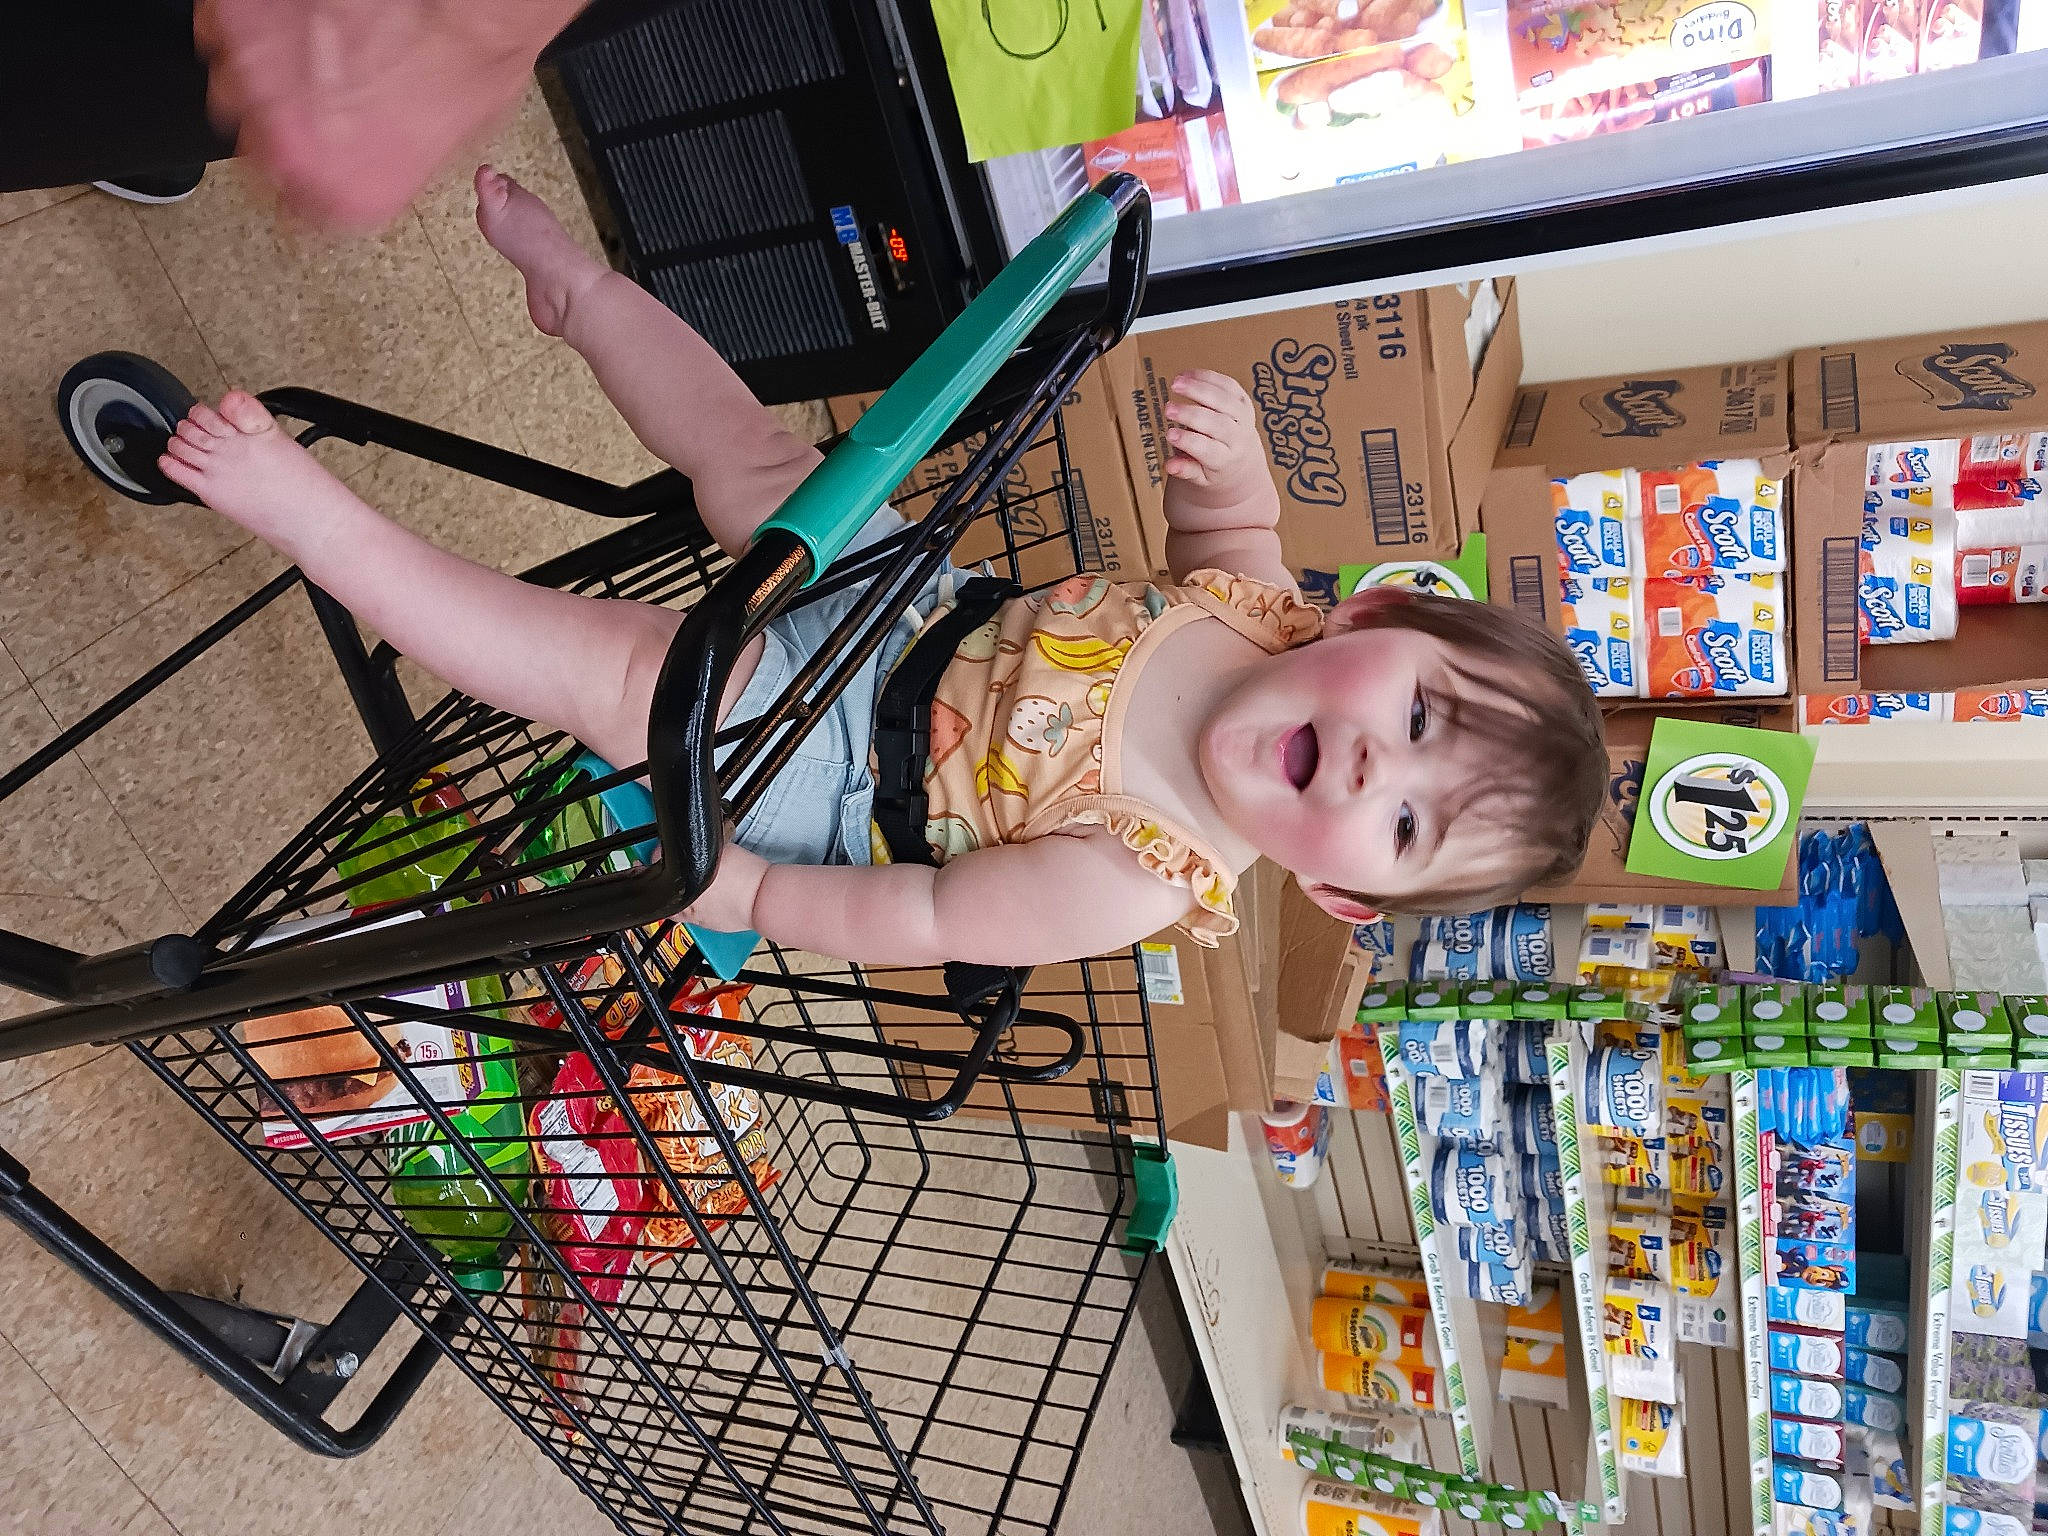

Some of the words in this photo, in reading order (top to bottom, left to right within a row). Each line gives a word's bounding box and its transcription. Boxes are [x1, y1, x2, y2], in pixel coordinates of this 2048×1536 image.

[1682, 18, 1743, 48] Dino
[829, 205, 859, 246] MB
[847, 241, 887, 330] MASTER-BILT
[1352, 315, 1371, 332] pk
[1373, 294, 1407, 361] 3116
[1251, 361, 1289, 412] and
[1934, 354, 2032, 396] Scott
[1131, 389, 1150, 430] MADE
[1270, 338, 1347, 508] Strong
[1140, 431, 1155, 449] IN
[1262, 412, 1300, 471] Soft
[1906, 452, 1931, 480] Scott
[1606, 497, 1623, 508] 4
[1758, 484, 1776, 497] 4
[1405, 482, 1428, 545] 23116
[1753, 510, 1764, 542] ROLLS
[1762, 510, 1776, 556] REGULAR
[1913, 522, 1932, 532] 4
[1095, 517, 1122, 573] 23116
[1555, 519, 1602, 569] Scott
[1602, 521, 1613, 550] ROLLS
[1611, 521, 1623, 564] REGULAR
[1702, 508, 1750, 561] Scott
[1914, 564, 1932, 575] 4
[1614, 618, 1630, 630] 4
[1756, 609, 1773, 621] 4
[1858, 585, 1903, 631] Scott
[1617, 642, 1630, 683] REGULAR
[1702, 631, 1749, 684] Scott
[1751, 634, 1762, 664] ROLLS
[1761, 634, 1773, 679] REGULAR
[1516, 934, 1532, 973] SHEETS
[1528, 929, 1551, 976] 1000
[1459, 1082, 1472, 1117] 1000
[1612, 1074, 1628, 1117] SHEETS
[1624, 1069, 1649, 1122] 1000
[2001, 1104, 2036, 1164] TISSUES
[1456, 1167, 1471, 1209] SHEETS
[1467, 1164, 1489, 1213] 1000
[1987, 1200, 2007, 1234] TISSUES
[1427, 1252, 1439, 1275] Grab
[1578, 1272, 1592, 1294] Grab
[1432, 1285, 1446, 1312] Before
[1748, 1296, 1759, 1332] Extreme
[1583, 1305, 1597, 1332] Before
[1932, 1312, 1945, 1349] Extreme
[1441, 1326, 1453, 1351] Gone!
[1749, 1335, 1761, 1358] Value
[1588, 1348, 1601, 1373] Gone!
[1930, 1353, 1943, 1377] Value
[1749, 1361, 1762, 1400] Everyday
[1927, 1380, 1942, 1420] Everyday
